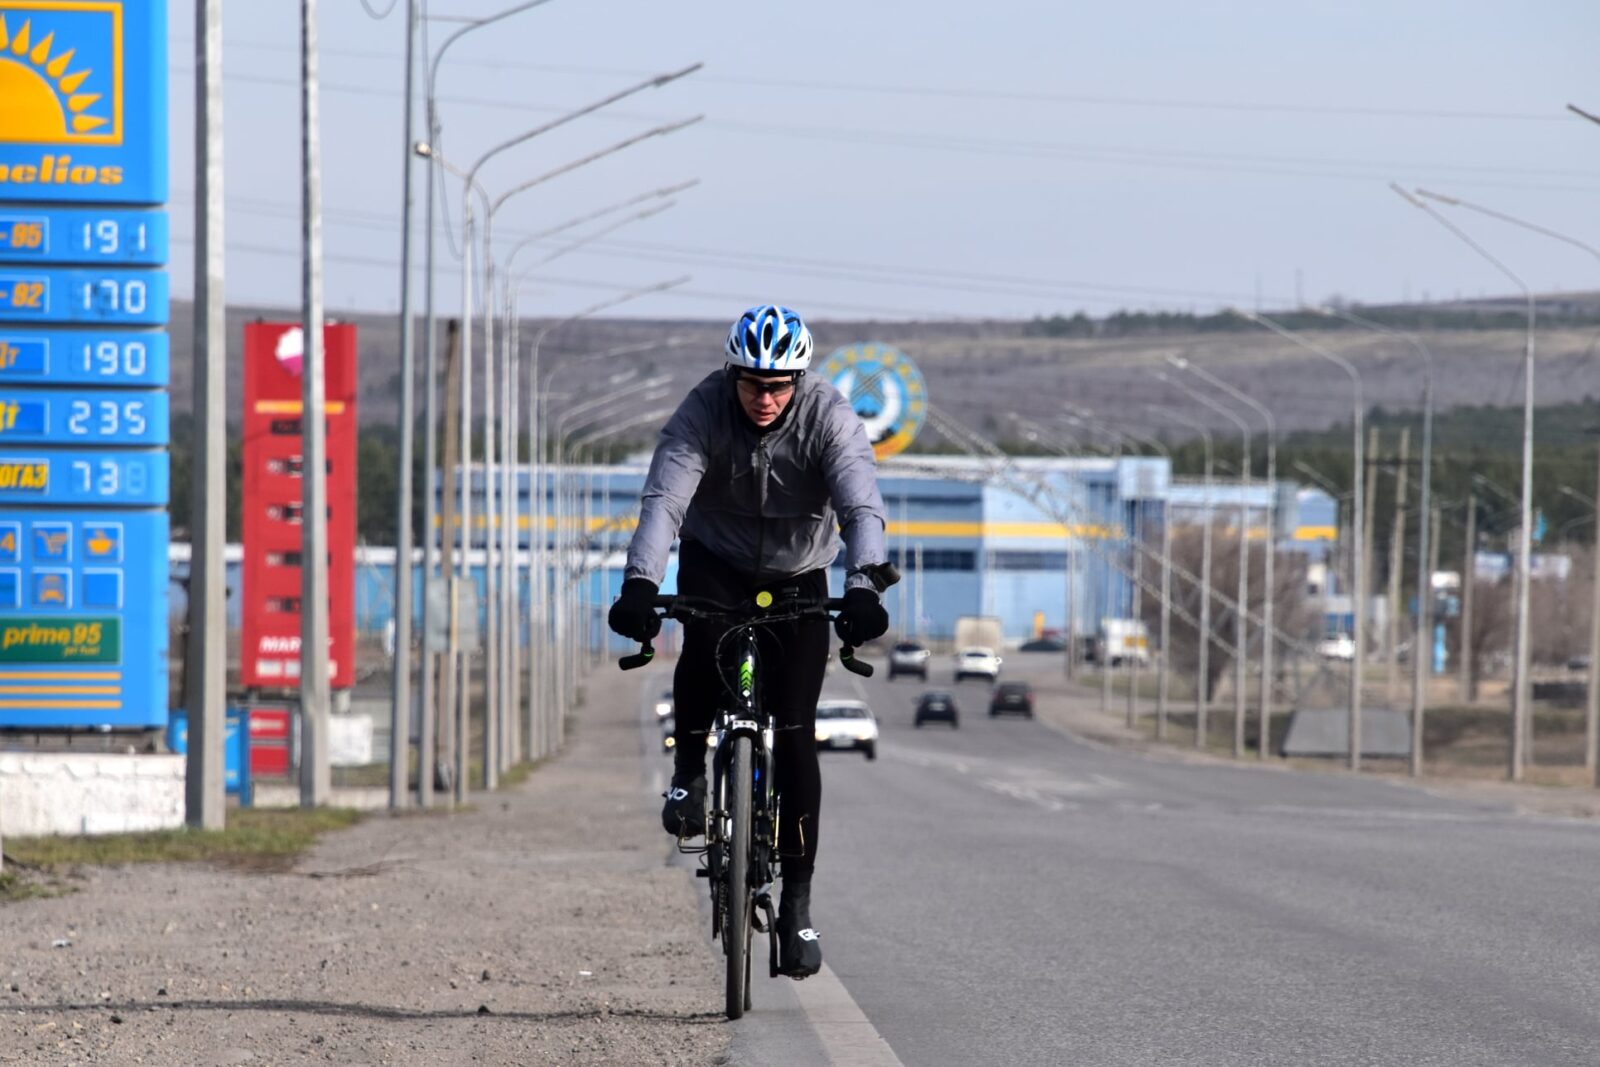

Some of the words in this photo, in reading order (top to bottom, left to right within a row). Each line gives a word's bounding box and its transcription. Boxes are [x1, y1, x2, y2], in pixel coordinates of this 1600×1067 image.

[83, 220, 146, 253] 191
[83, 279, 146, 314] 170
[83, 341, 146, 376] 190
[69, 400, 146, 435] 235
[4, 623, 70, 650] prime
[73, 622, 102, 645] 95
